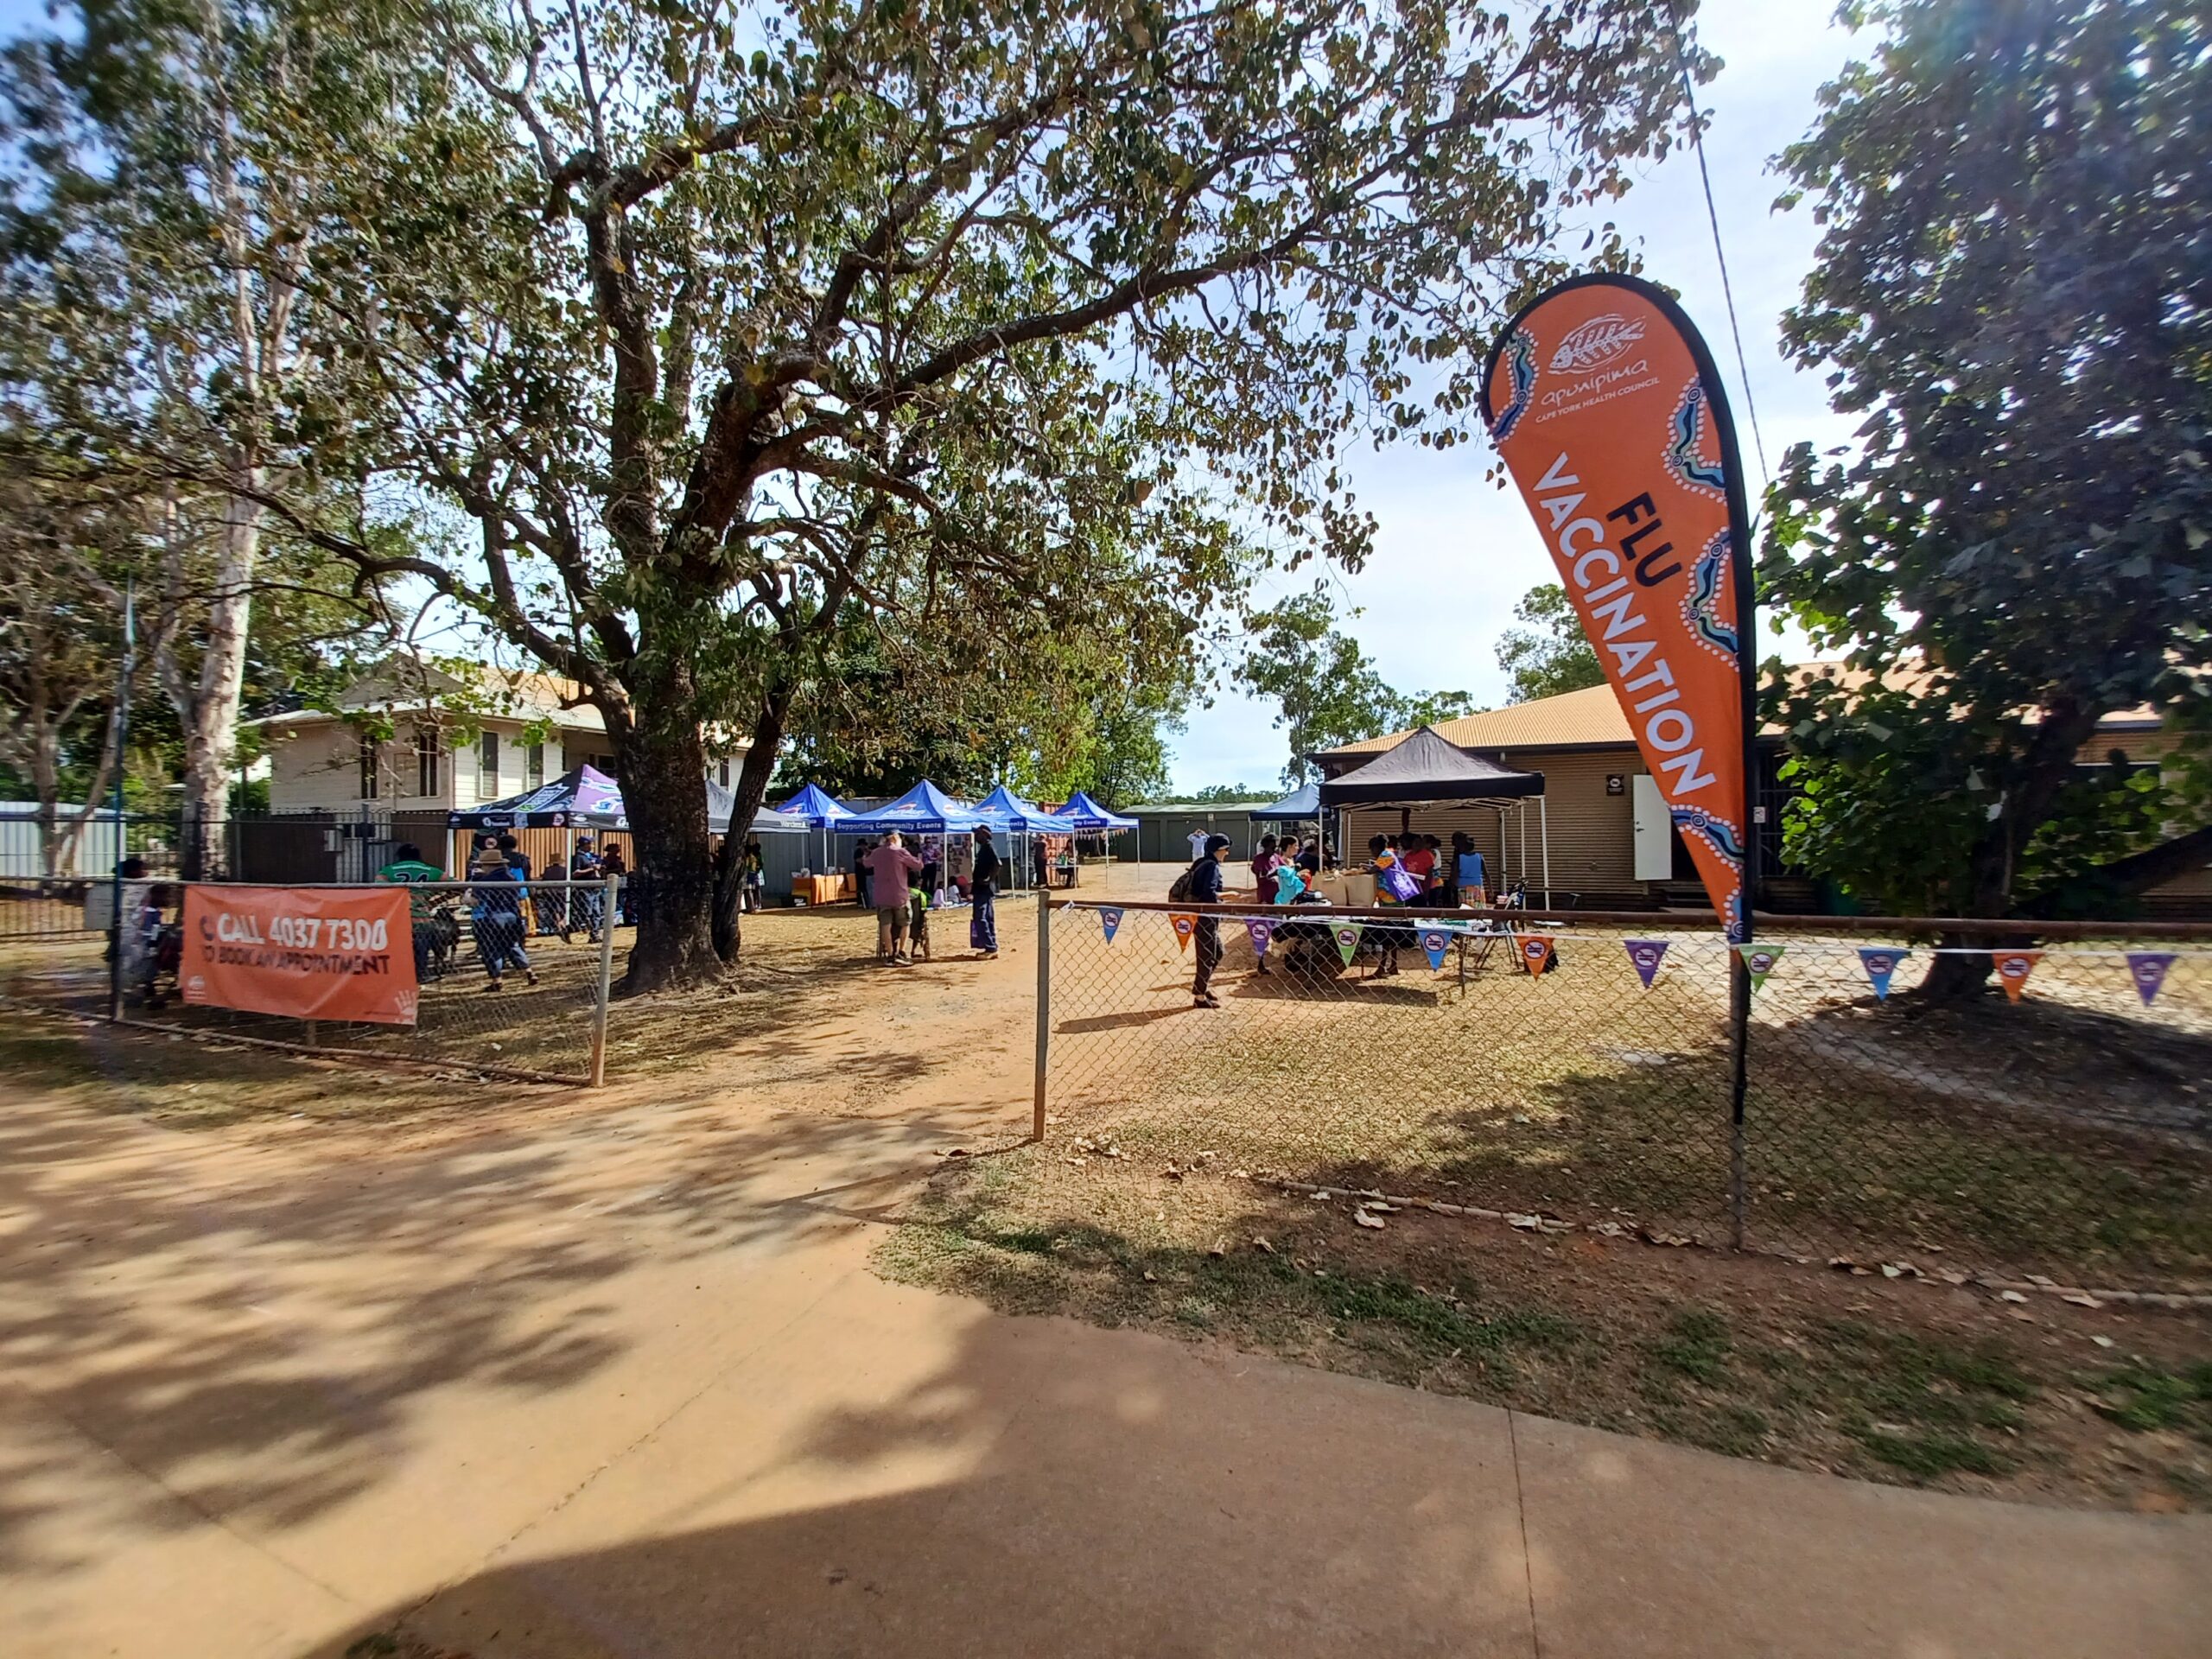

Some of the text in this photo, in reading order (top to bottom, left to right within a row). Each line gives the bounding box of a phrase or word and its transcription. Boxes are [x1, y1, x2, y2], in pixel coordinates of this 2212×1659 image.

[1535, 377, 1660, 423] CAPE YORK HEALTH COUNCIL
[1541, 359, 1649, 407] apunipima
[1606, 492, 1682, 588] FLU
[1533, 452, 1717, 798] VACCINATION
[875, 822, 915, 830] Community
[217, 912, 388, 951] CALL 4037 7300
